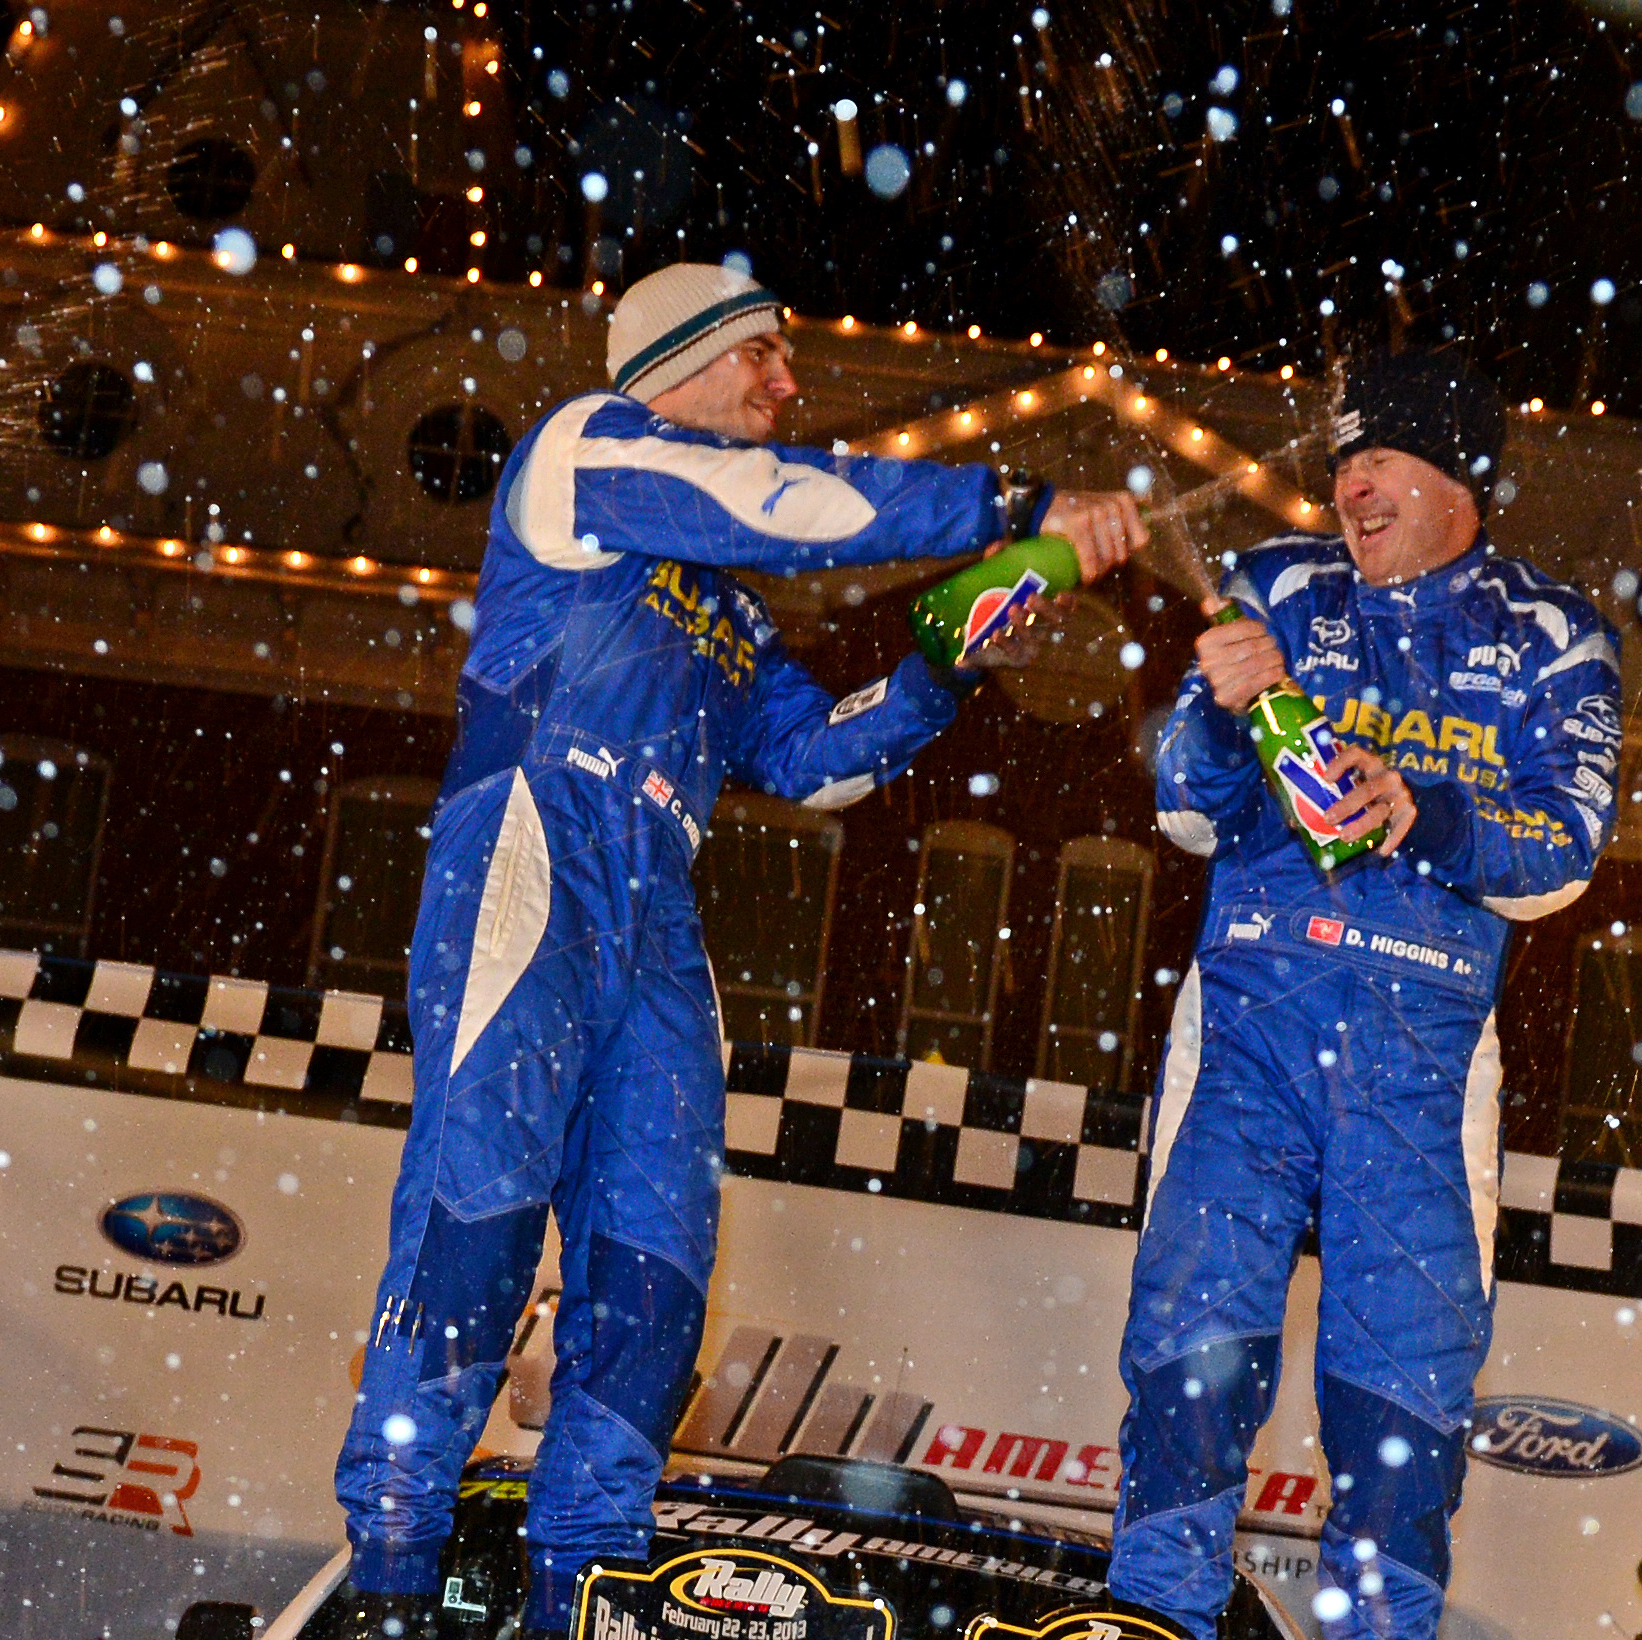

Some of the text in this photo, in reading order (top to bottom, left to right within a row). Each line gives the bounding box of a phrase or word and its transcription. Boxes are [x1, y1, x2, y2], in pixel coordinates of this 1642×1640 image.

[1345, 928, 1365, 948] D.
[1370, 934, 1449, 969] HIGGINS
[54, 1263, 267, 1321] SUBARU
[1484, 1403, 1610, 1468] Ford
[658, 1501, 862, 1556] Rally
[692, 1557, 808, 1618] Rally
